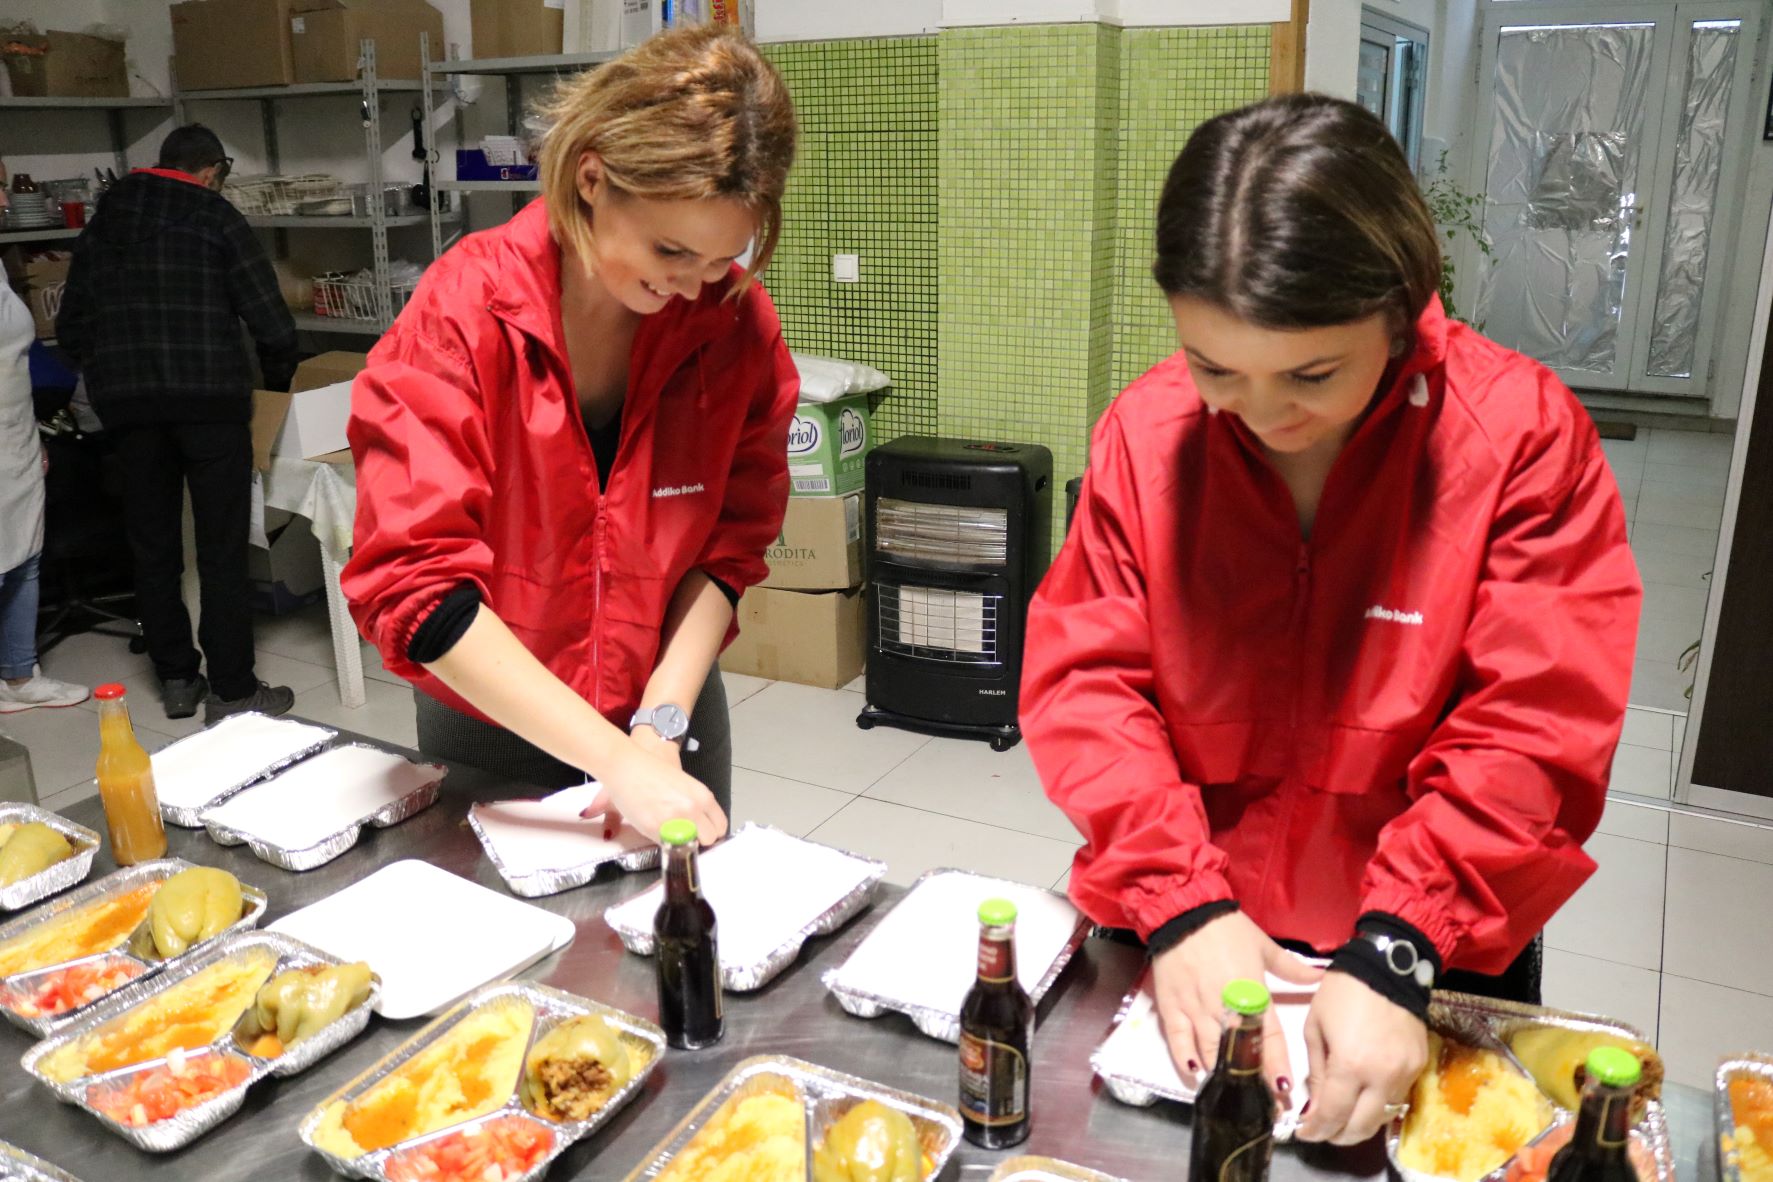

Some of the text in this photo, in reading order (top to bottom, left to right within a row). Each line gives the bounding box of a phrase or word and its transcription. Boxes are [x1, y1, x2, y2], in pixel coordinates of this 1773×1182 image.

[653, 483, 704, 498] Addiko Bank
[1394, 609, 1423, 625] Bank
